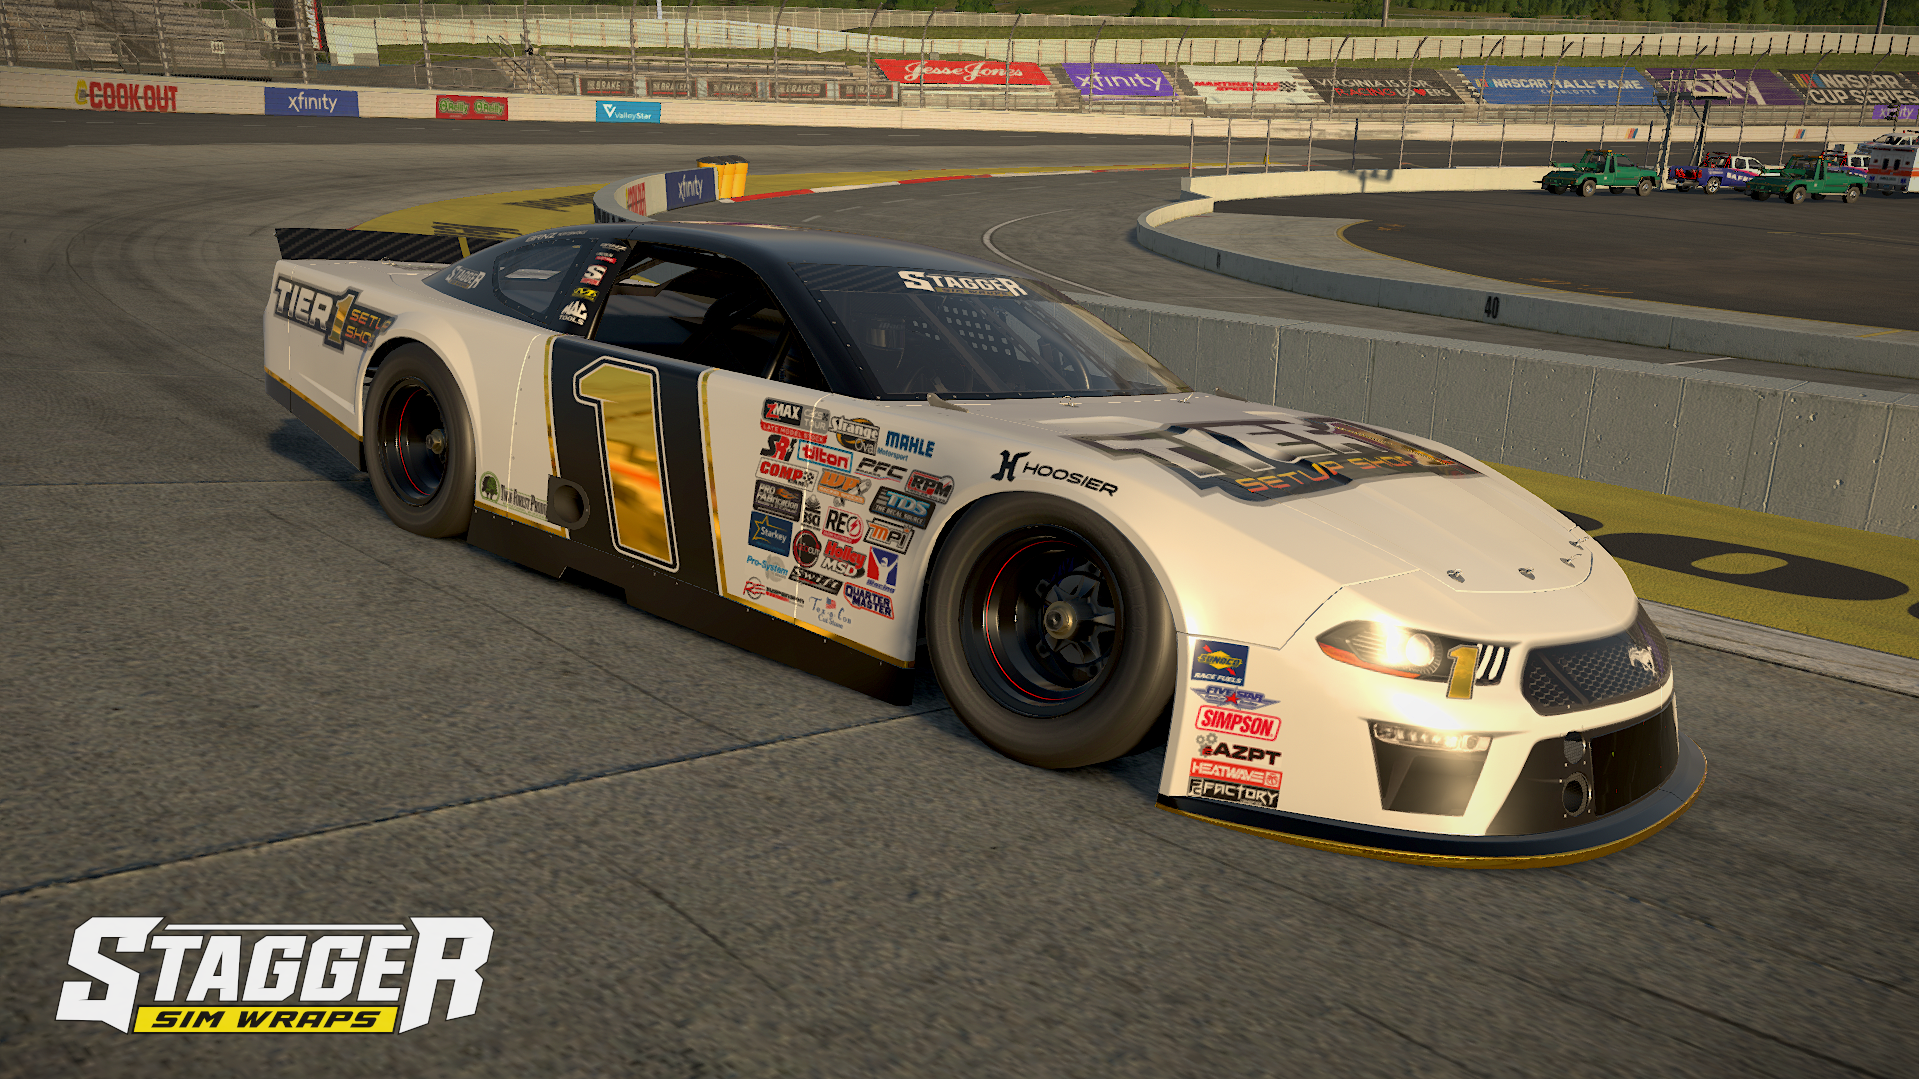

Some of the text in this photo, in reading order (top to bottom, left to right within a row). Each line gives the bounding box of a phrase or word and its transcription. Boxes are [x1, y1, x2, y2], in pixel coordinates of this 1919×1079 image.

[899, 61, 1024, 82] Jesse Jones
[1077, 71, 1162, 91] xfinity
[1313, 79, 1433, 87] VIRGINIA IS FOR
[1818, 73, 1903, 88] NASCAR
[1333, 87, 1396, 96] RACING
[1492, 78, 1548, 88] NASCAR
[1596, 79, 1644, 90] FAME
[89, 81, 178, 113] COOK OUT
[288, 91, 338, 113] xfinity
[1809, 89, 1919, 104] CUP SERIES
[677, 174, 704, 202] xfinity
[445, 265, 487, 289] STAGGER
[897, 270, 1029, 297] STAGGER
[276, 279, 356, 345] TIER 1
[1484, 296, 1500, 319] 40
[829, 415, 880, 441] Strange
[885, 430, 936, 458] MAHLE
[574, 359, 678, 572] 1
[802, 444, 849, 469] tilton
[760, 461, 804, 482] COMP
[857, 457, 909, 480] PFC
[1022, 461, 1119, 497] HOOSIER
[1235, 461, 1345, 493] SETUP
[911, 474, 953, 498] RPM
[874, 504, 886, 512] THE
[885, 490, 931, 517] TDS
[761, 526, 788, 544] Starkey
[824, 540, 867, 569] Holley
[820, 556, 859, 578] MSD
[845, 584, 891, 606] QUARTER
[852, 595, 892, 617] MASTER
[1198, 653, 1241, 668] SUNOCO
[1446, 645, 1480, 699] 1
[1194, 672, 1243, 684] RACE FUELS
[1201, 709, 1275, 737] SIMPSON
[1192, 761, 1265, 784] HEATWAVE
